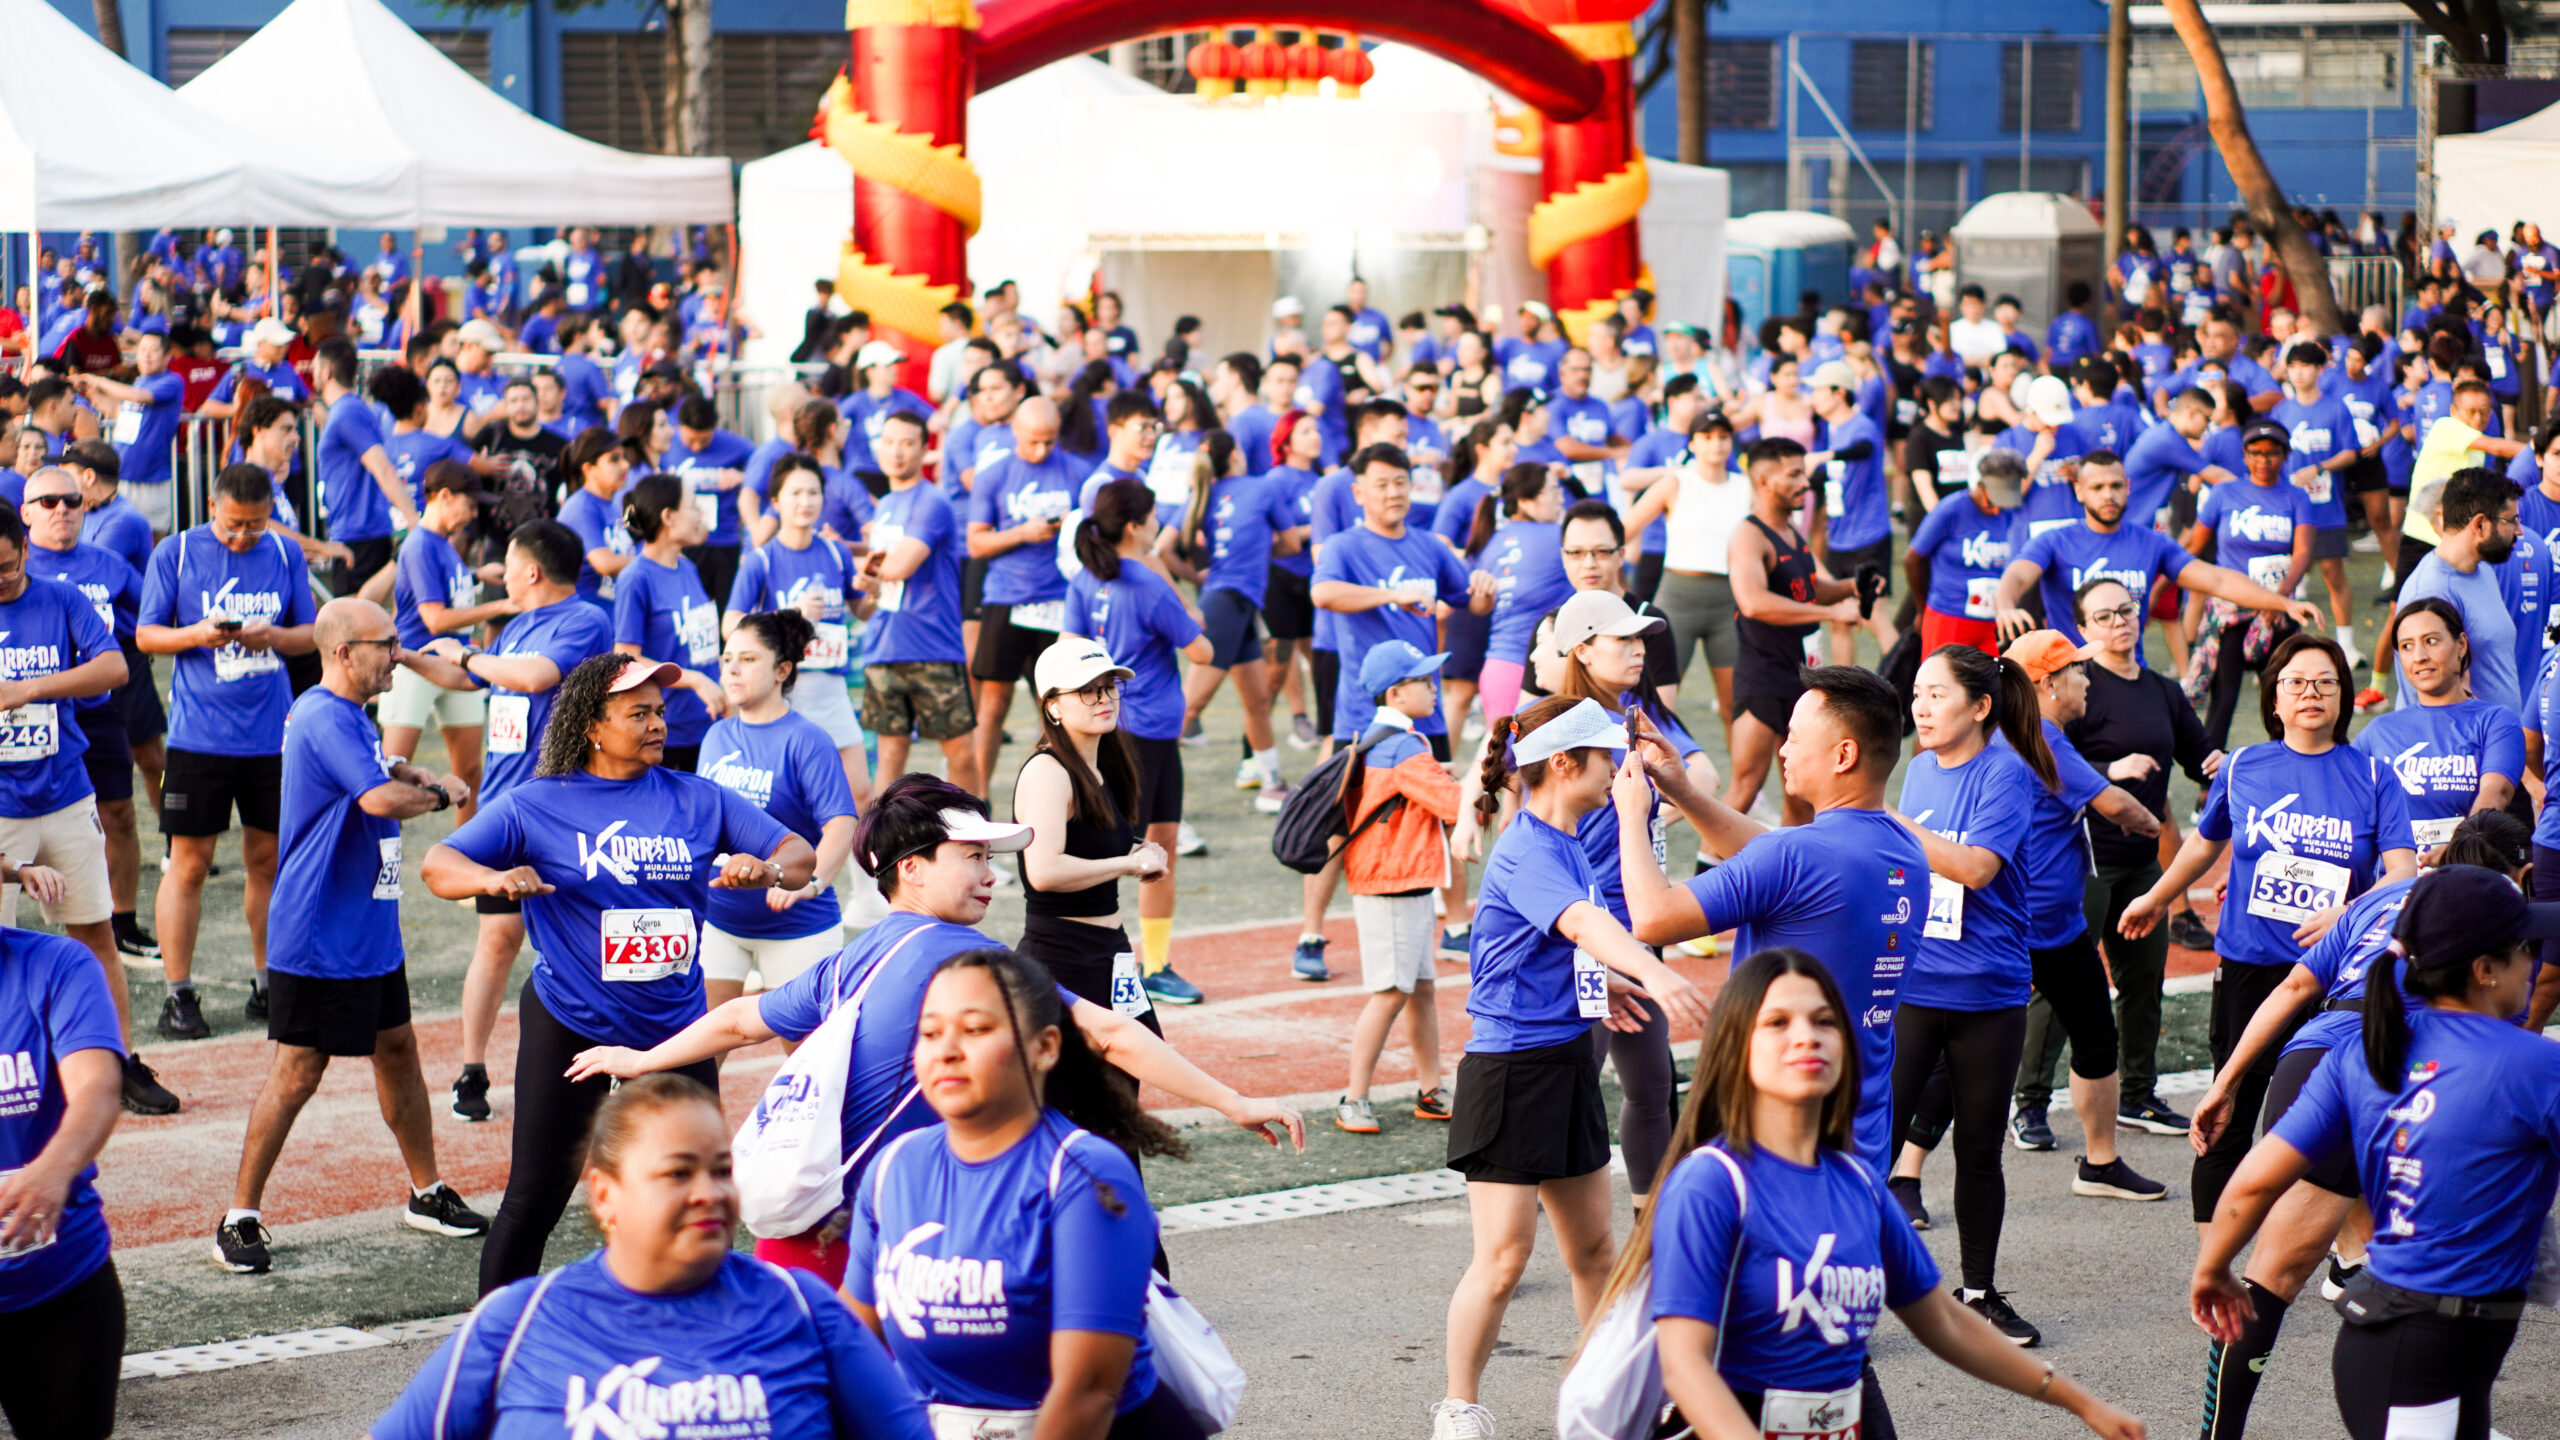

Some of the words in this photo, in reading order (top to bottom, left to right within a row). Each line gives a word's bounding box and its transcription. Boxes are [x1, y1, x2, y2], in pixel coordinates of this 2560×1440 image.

[2431, 776, 2467, 785] MURALHA
[2302, 838, 2342, 850] MURALHA
[2343, 844, 2353, 852] DE
[577, 820, 693, 885] KORRIDA
[2304, 845, 2322, 855] SÃO
[2324, 848, 2350, 860] PAULO
[644, 864, 683, 872] MURALHA
[646, 872, 664, 880] SÃO
[666, 873, 691, 881] PAULO
[2256, 876, 2331, 912] 5306
[609, 935, 687, 963] 7330
[1580, 971, 1606, 999] 53
[961, 1321, 1007, 1335] PAULO
